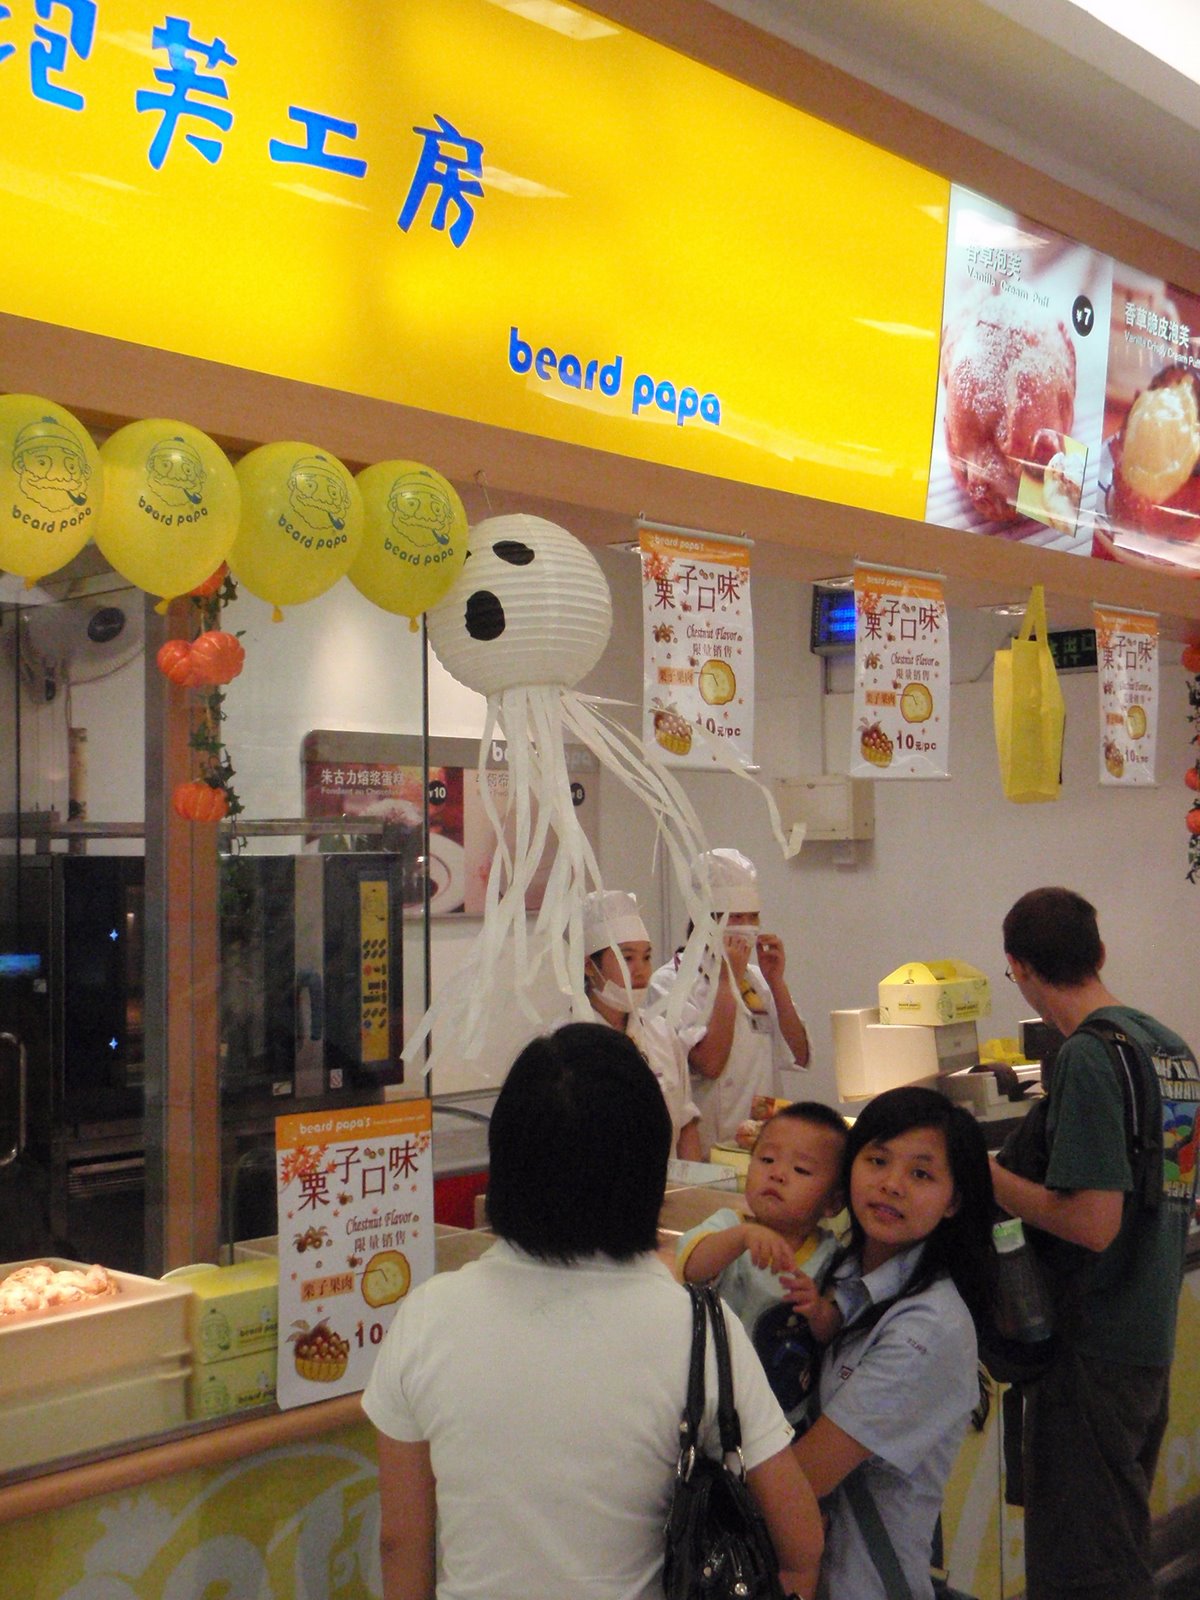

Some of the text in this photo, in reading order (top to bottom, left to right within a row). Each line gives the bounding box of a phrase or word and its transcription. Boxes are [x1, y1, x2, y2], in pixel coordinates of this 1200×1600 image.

[0, 0, 484, 248] 泡芙工房
[967, 265, 998, 287] Vanilla
[509, 326, 721, 427] beard papa
[12, 504, 92, 533] beard papa
[138, 496, 209, 526] beard papa
[278, 514, 347, 550] beard papa
[384, 538, 454, 567] beard papa
[655, 564, 741, 612] 栗子口味
[687, 624, 737, 640] Chestnut Flavor
[865, 600, 940, 640] 栗子口味
[1103, 636, 1152, 670] 栗子口味
[300, 1120, 333, 1135] beard
[336, 1117, 371, 1133] papa's
[298, 1140, 418, 1211] 栗子口味
[346, 1209, 412, 1236] Chestnut Flavor
[355, 1323, 388, 1348] 10
